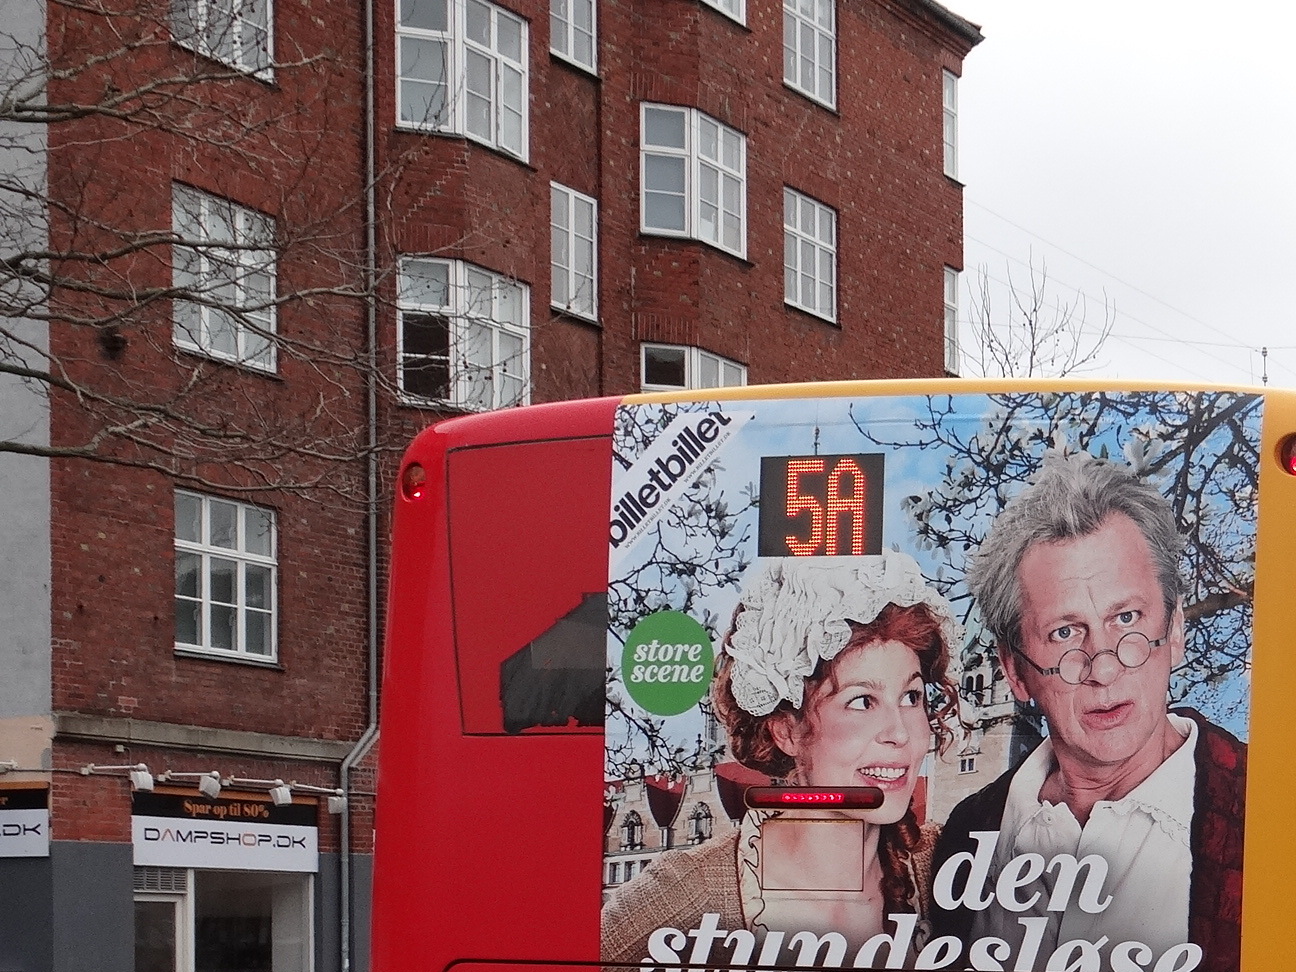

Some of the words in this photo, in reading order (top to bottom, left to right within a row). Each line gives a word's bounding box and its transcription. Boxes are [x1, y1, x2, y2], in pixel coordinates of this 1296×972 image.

[785, 458, 865, 556] 5A
[633, 639, 702, 662] store
[630, 662, 704, 683] scene
[183, 800, 211, 817] Spar
[212, 805, 227, 819] op
[229, 803, 240, 816] til
[243, 803, 270, 818] 80%
[143, 827, 307, 850] DAMPSHOP.DK
[932, 830, 1114, 914] den
